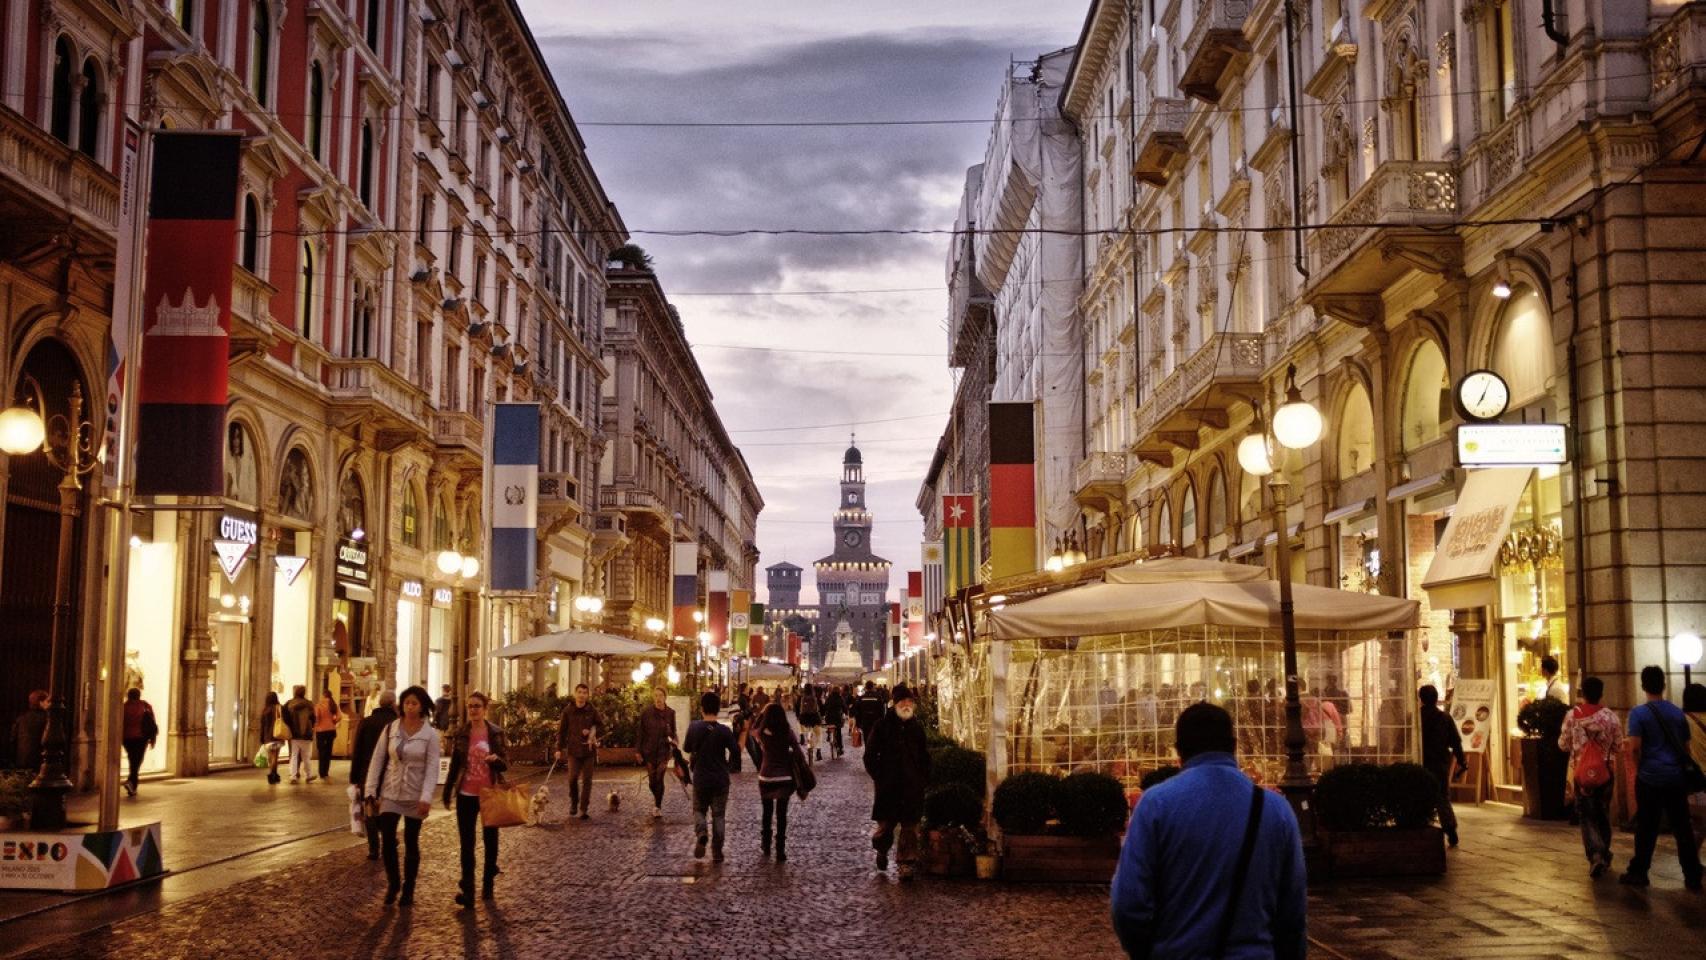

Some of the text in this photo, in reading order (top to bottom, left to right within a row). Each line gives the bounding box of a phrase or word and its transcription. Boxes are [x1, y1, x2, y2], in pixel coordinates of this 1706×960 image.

[221, 515, 257, 545] GUESS
[403, 581, 422, 597] ALDO
[3, 841, 68, 862] EXPO
